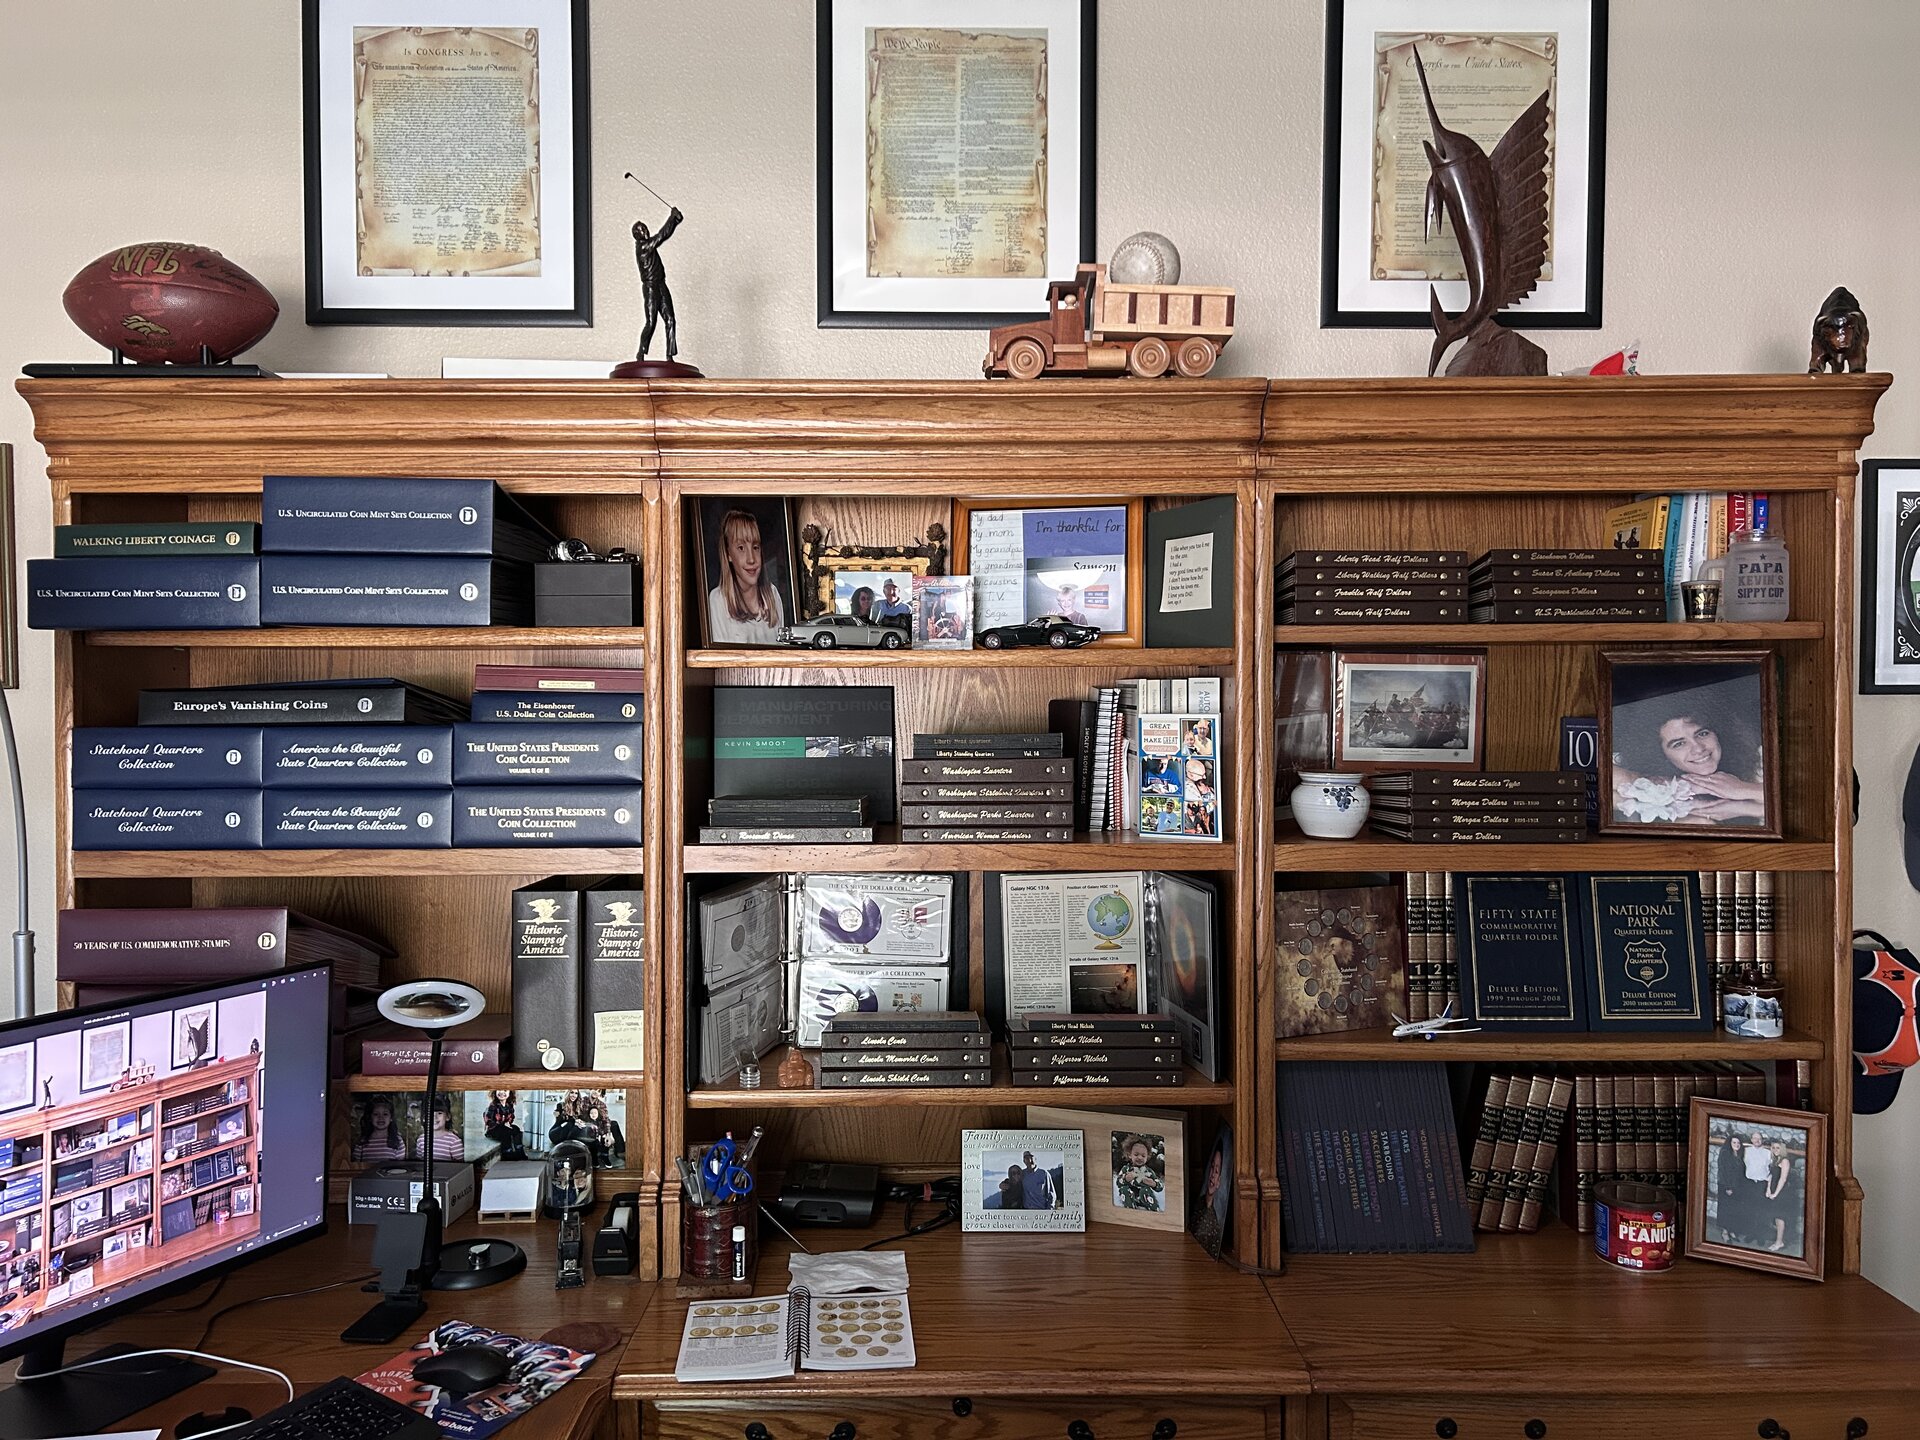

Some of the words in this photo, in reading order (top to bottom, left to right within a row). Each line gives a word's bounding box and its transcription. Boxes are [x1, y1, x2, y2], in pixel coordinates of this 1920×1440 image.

[111, 248, 181, 277] NFL
[295, 510, 348, 518] UNCIRCULATED
[350, 510, 368, 518] COIN
[370, 510, 389, 518] MINT
[391, 511, 407, 519] SETS
[409, 511, 452, 519] COLLECTION
[988, 513, 1004, 522] dad
[1036, 521, 1052, 533] I'm
[1057, 517, 1099, 533] thankful
[989, 529, 1014, 538] mom
[73, 537, 122, 546] WALKING
[125, 535, 166, 545] LIBERTY
[169, 535, 215, 544] COINAGE
[1334, 555, 1359, 563] Liberty
[1362, 555, 1380, 563] Head
[1383, 555, 1401, 564] Half
[1402, 555, 1428, 563] Dollars
[1738, 563, 1783, 573] PAPA
[1738, 575, 1784, 586] KEVIN'S
[36, 590, 53, 598] U.S.
[55, 590, 110, 598] UNCIRCULATED
[111, 590, 132, 598] COIN
[133, 590, 154, 598] MINT
[156, 590, 173, 598] SETS
[176, 590, 220, 598] COLLECTION
[1738, 588, 1766, 599] SIPPY
[1768, 588, 1784, 598] CUP
[1334, 608, 1363, 617] Kennedy
[1365, 608, 1382, 617] Half
[173, 700, 226, 712] Europe's
[231, 700, 290, 712] Vanishing
[293, 700, 328, 710] Coins
[90, 744, 148, 755] Statehood
[154, 744, 204, 756] Quarters
[283, 744, 330, 754] America
[332, 744, 348, 754] the
[350, 743, 402, 756] Beautiful
[467, 743, 485, 752] THE
[487, 743, 518, 752] UNITED
[520, 743, 550, 752] STATES
[552, 743, 599, 752] PRESIDENTS
[118, 759, 175, 770] Collection
[276, 757, 304, 768] State
[307, 757, 354, 768] Quarters
[357, 757, 408, 768] Collection
[496, 754, 518, 764] COIN
[520, 754, 570, 764] COLLECTION
[942, 766, 981, 776] Washington
[983, 766, 1013, 775] Quarters
[1452, 779, 1476, 787] United
[1478, 779, 1502, 787] States
[1503, 780, 1520, 788] Type
[1452, 799, 1479, 807] Morgan
[1479, 910, 1514, 919] FIFTY
[1521, 910, 1558, 919] STATE
[1610, 905, 1675, 916] NATIONAL
[1627, 917, 1660, 927] PARK
[525, 925, 562, 935] Historic
[1614, 928, 1646, 936] QUARTERS
[84, 942, 108, 950] YEARS
[110, 941, 120, 950] OF
[134, 940, 200, 949] COMMEMORATIVE
[202, 939, 231, 948] STAMPS
[520, 935, 556, 946] Stamps
[556, 934, 568, 946] of
[522, 945, 564, 954] America
[1415, 964, 1422, 974] 1
[1434, 964, 1442, 974] 2
[1760, 962, 1772, 973] 19
[1488, 985, 1519, 993] DELUXE
[861, 1036, 886, 1045] Lincoln
[888, 1036, 907, 1046] Cents
[1051, 1036, 1076, 1046] Buffalo
[1078, 1036, 1102, 1044] Nickels
[964, 1130, 1004, 1143] Family
[1400, 1130, 1410, 1153] STARS
[1370, 1130, 1385, 1184] SPACEFARERS
[1380, 1132, 1394, 1180] STARBOUND
[1316, 1150, 1327, 1182] SEARCH
[1342, 1130, 1354, 1164] COSMIC
[1348, 1168, 1360, 1210] MYSTERIES
[1471, 1172, 1486, 1183] 20
[1492, 1172, 1506, 1184] 21
[1513, 1172, 1528, 1184] 22
[1533, 1172, 1548, 1184] 23
[1579, 1174, 1594, 1185] 24
[964, 1212, 1000, 1220] Together
[1048, 1210, 1083, 1223] family
[1618, 1224, 1675, 1243] PEANUTS
